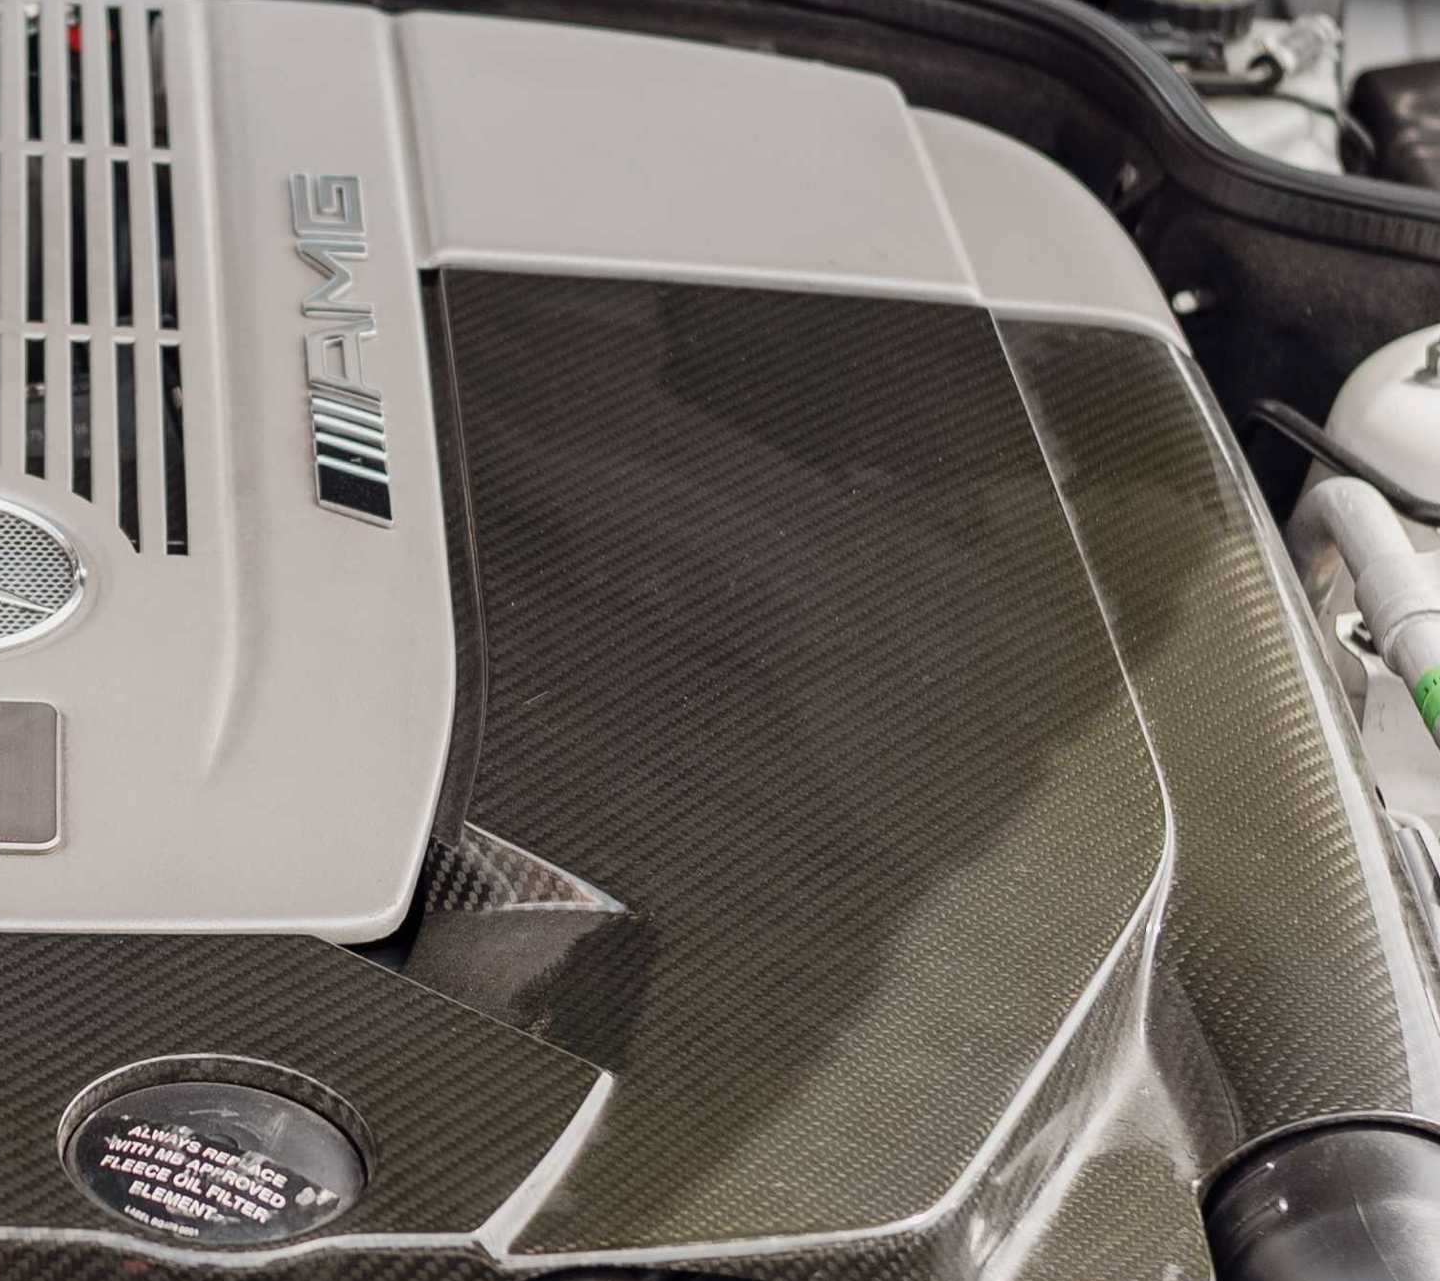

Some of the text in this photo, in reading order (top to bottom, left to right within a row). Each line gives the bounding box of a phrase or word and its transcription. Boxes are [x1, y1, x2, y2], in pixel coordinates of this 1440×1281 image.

[288, 171, 383, 405] AMG
[99, 1154, 272, 1224] FLEECE OIL FILTER
[107, 1135, 287, 1211] WITH MB APPROVED
[127, 1123, 289, 1189] ALWAYS REPLACE
[128, 1180, 217, 1222] ELEMENT
